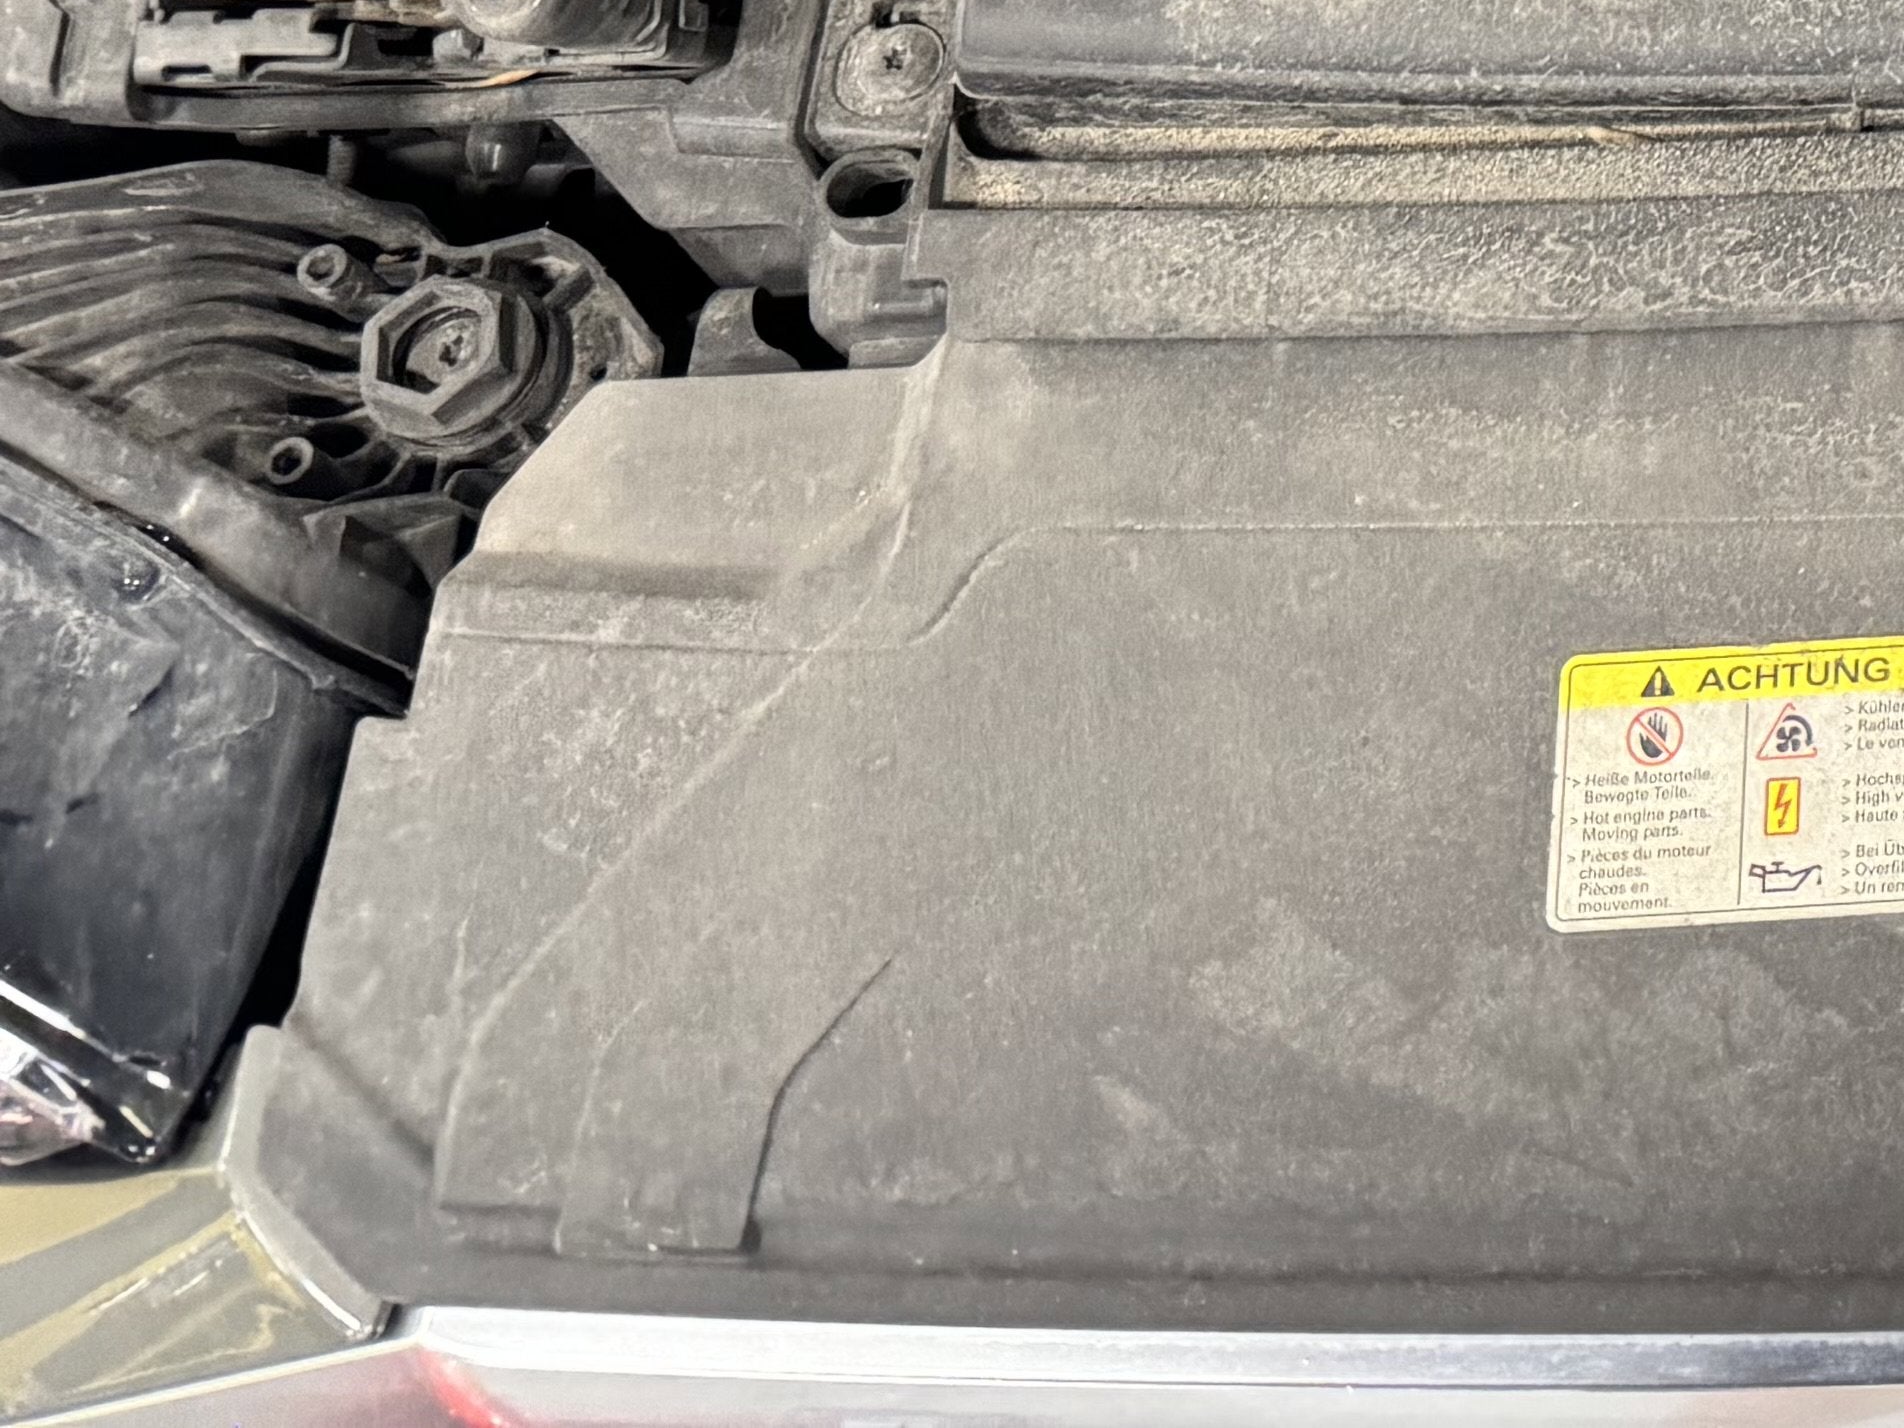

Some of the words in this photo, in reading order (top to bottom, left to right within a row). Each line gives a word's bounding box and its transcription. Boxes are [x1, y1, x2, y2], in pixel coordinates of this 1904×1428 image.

[1696, 656, 1891, 693] ACHTUNG
[1856, 737, 1874, 750] Le
[1584, 772, 1630, 786] Heiße
[1583, 787, 1649, 806] Bewegte
[1654, 784, 1692, 799] Teile.
[1855, 789, 1889, 806] High
[1583, 811, 1609, 824] Hot
[1612, 808, 1664, 825] engine
[1668, 806, 1712, 822] parts.
[1854, 808, 1897, 822] Haute
[1581, 826, 1638, 843] Moving
[1643, 824, 1684, 839] parts.
[1580, 846, 1629, 862] Pièces
[1632, 846, 1652, 859] du
[1656, 845, 1711, 857] moteur
[1855, 844, 1879, 858] Bei
[1578, 865, 1647, 879] chaudes.
[1578, 880, 1627, 896] Pièces
[1630, 882, 1650, 892] en
[1854, 881, 1876, 894] Un
[1577, 896, 1672, 913] mouvement.
